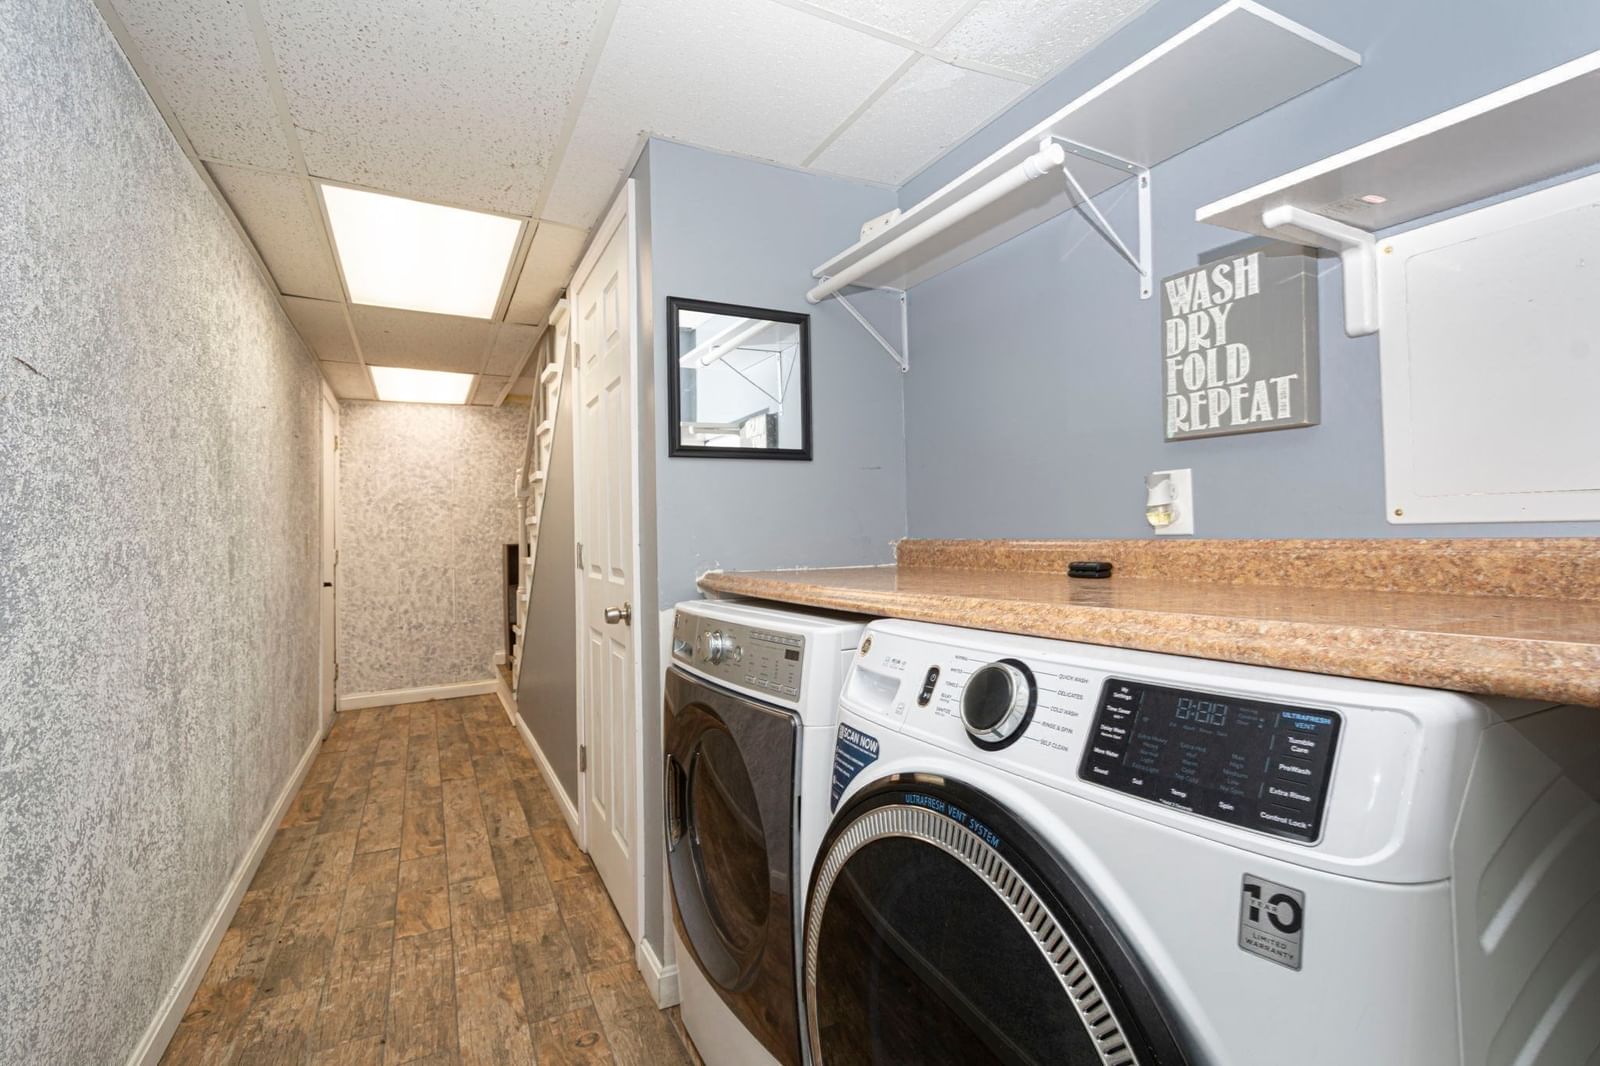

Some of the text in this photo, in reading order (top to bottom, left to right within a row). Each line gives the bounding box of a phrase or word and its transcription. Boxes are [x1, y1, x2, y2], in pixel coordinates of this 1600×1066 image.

[1165, 252, 1262, 317] WASH
[1165, 303, 1233, 357] DRY
[1166, 343, 1250, 395] FOLD
[1166, 374, 1298, 438] REPEAT
[1057, 689, 1084, 701] DELICATES
[1281, 711, 1332, 725] ULTRAFRESH
[1294, 721, 1316, 731] VENT
[843, 727, 860, 745] SCAN
[859, 735, 878, 753] NOW
[1287, 736, 1316, 747] Tumble
[1290, 745, 1310, 754] Care
[1268, 787, 1312, 802] Extra Rinse
[1218, 801, 1235, 811] Spin
[905, 792, 1000, 848] ULTRAFRESH VENT SYSTEM
[1259, 811, 1288, 824] Control
[1243, 883, 1303, 934] 10
[1245, 937, 1295, 961] WARRANTY
[1251, 932, 1288, 951] LIMITED
